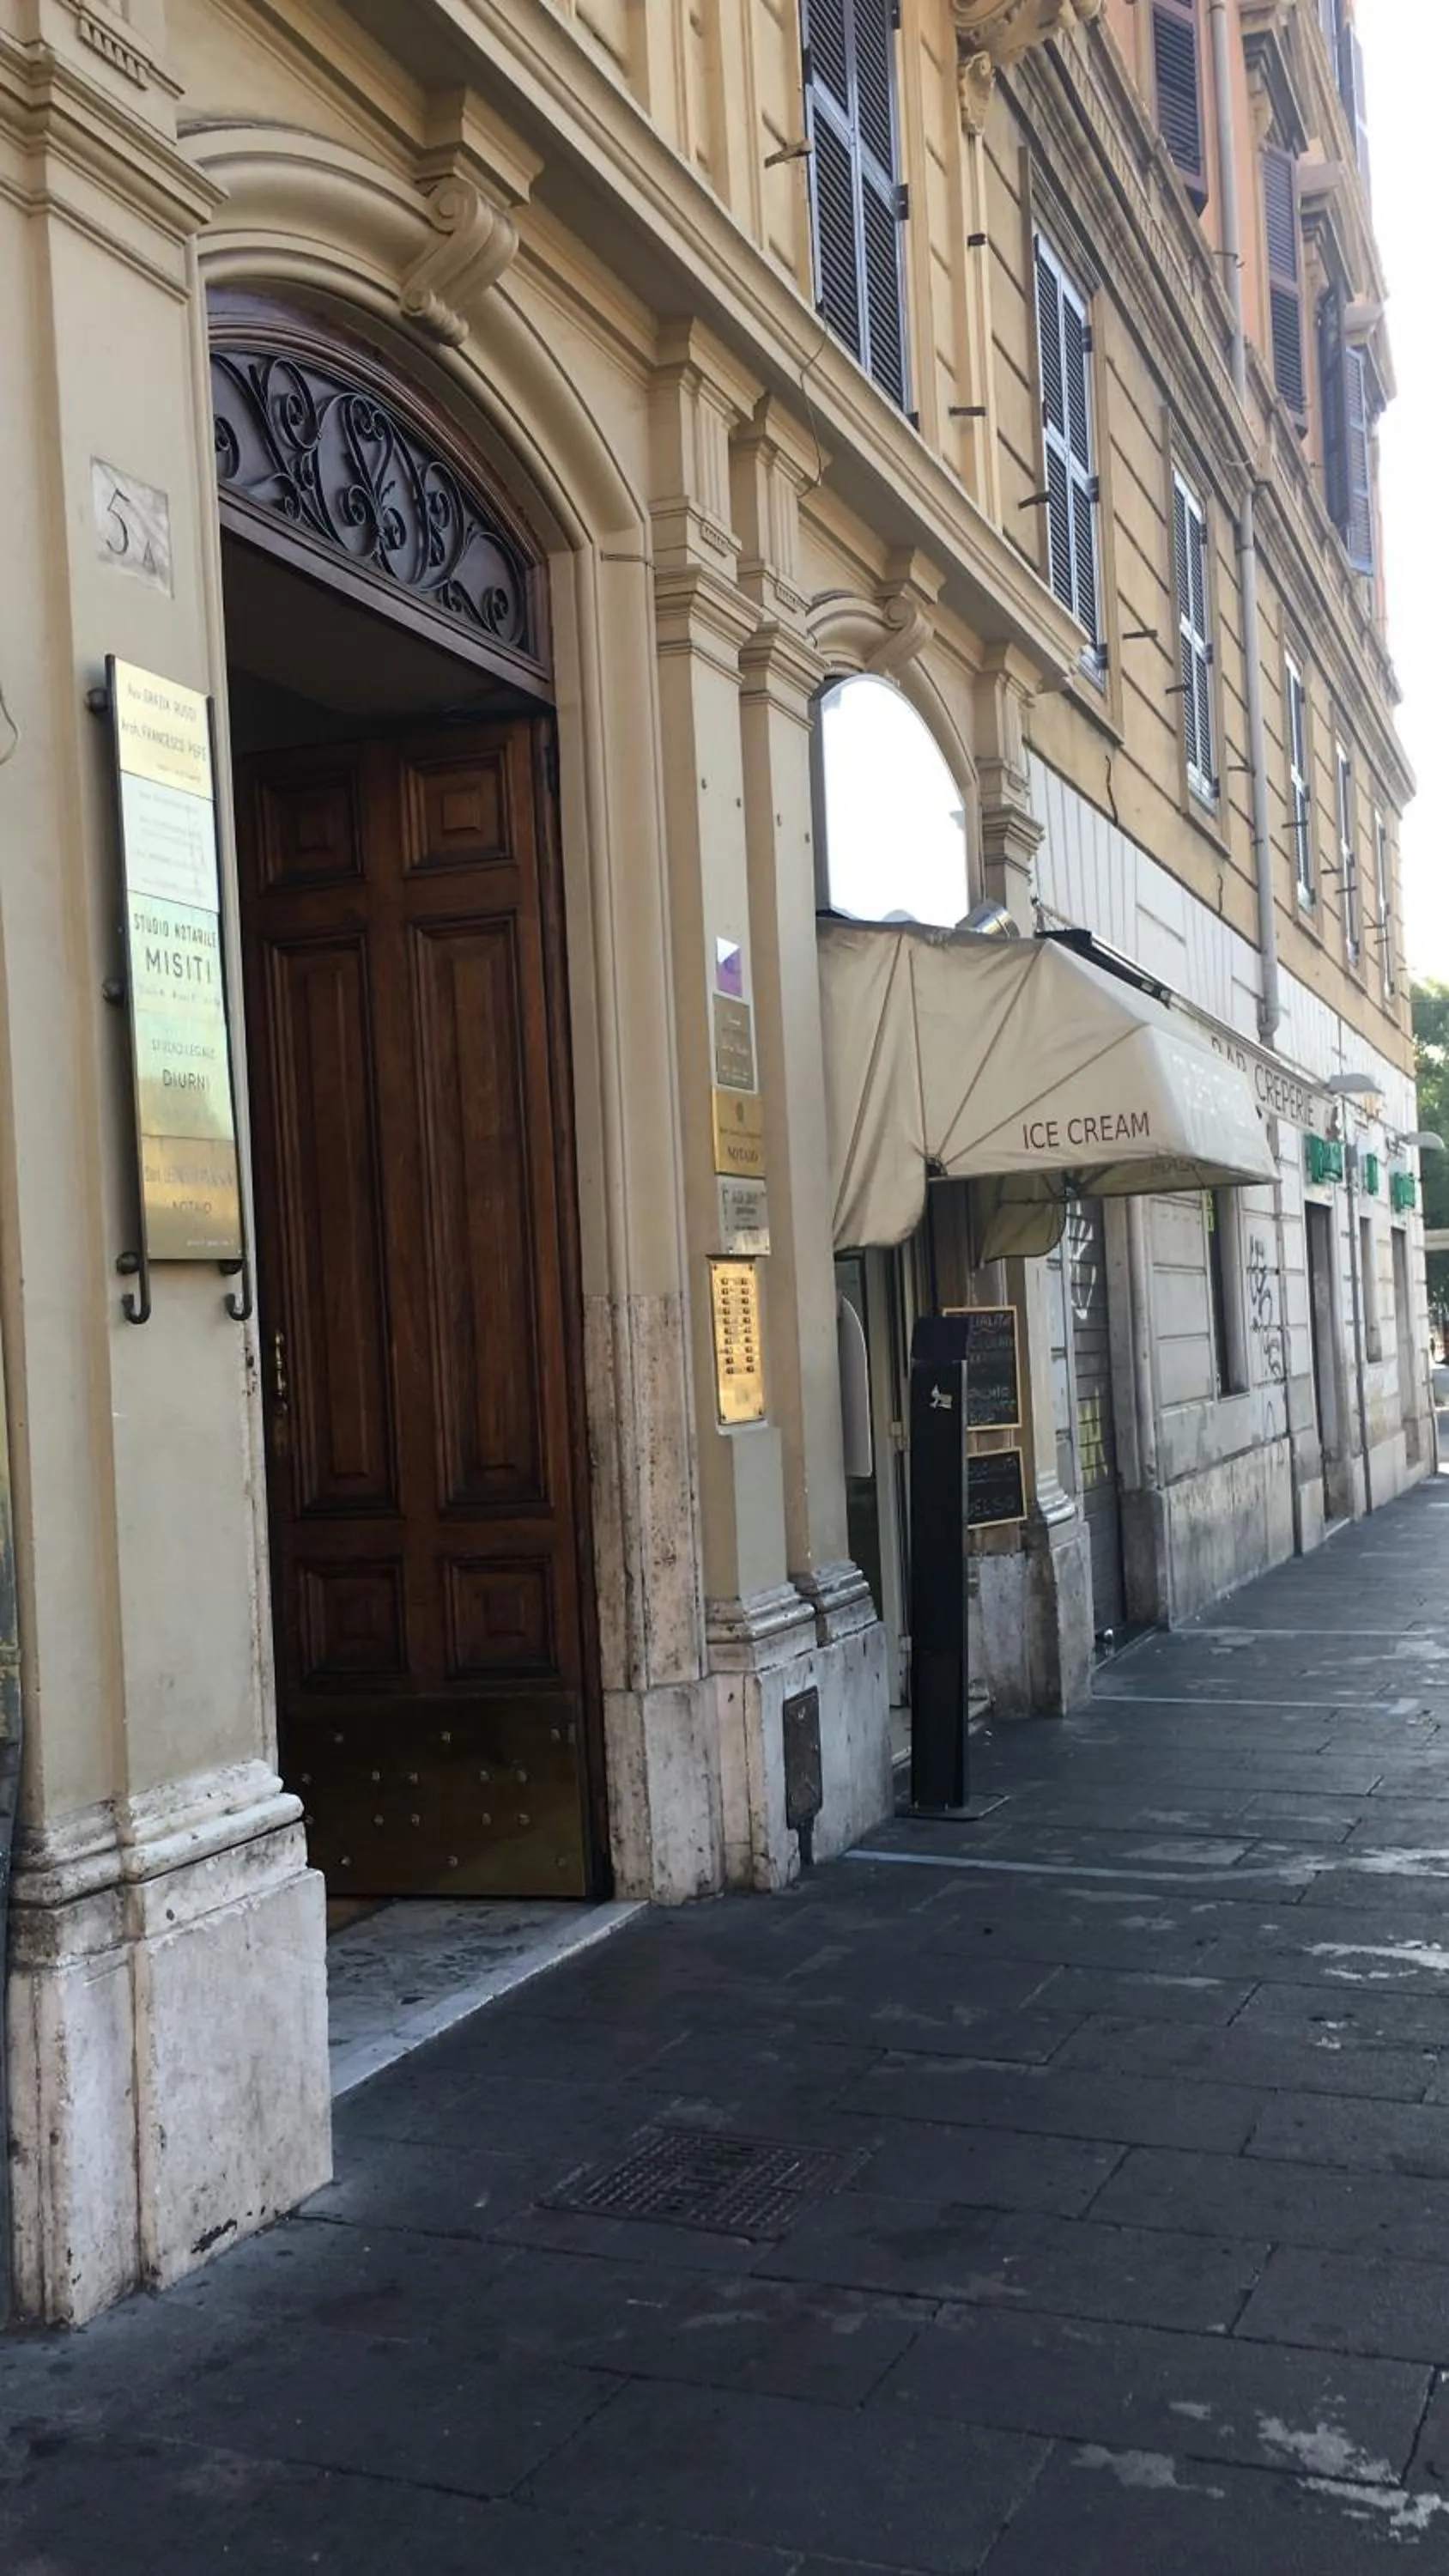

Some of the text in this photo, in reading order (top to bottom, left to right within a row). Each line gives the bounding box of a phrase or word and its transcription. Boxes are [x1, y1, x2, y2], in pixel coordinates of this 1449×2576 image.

[106, 488, 130, 556] 5
[134, 913, 216, 949] STUDIO NOTARILE
[145, 947, 211, 985] MISITI
[1254, 1064, 1314, 1127] CREPERIE
[1022, 1111, 1151, 1151] ICE CREAM
